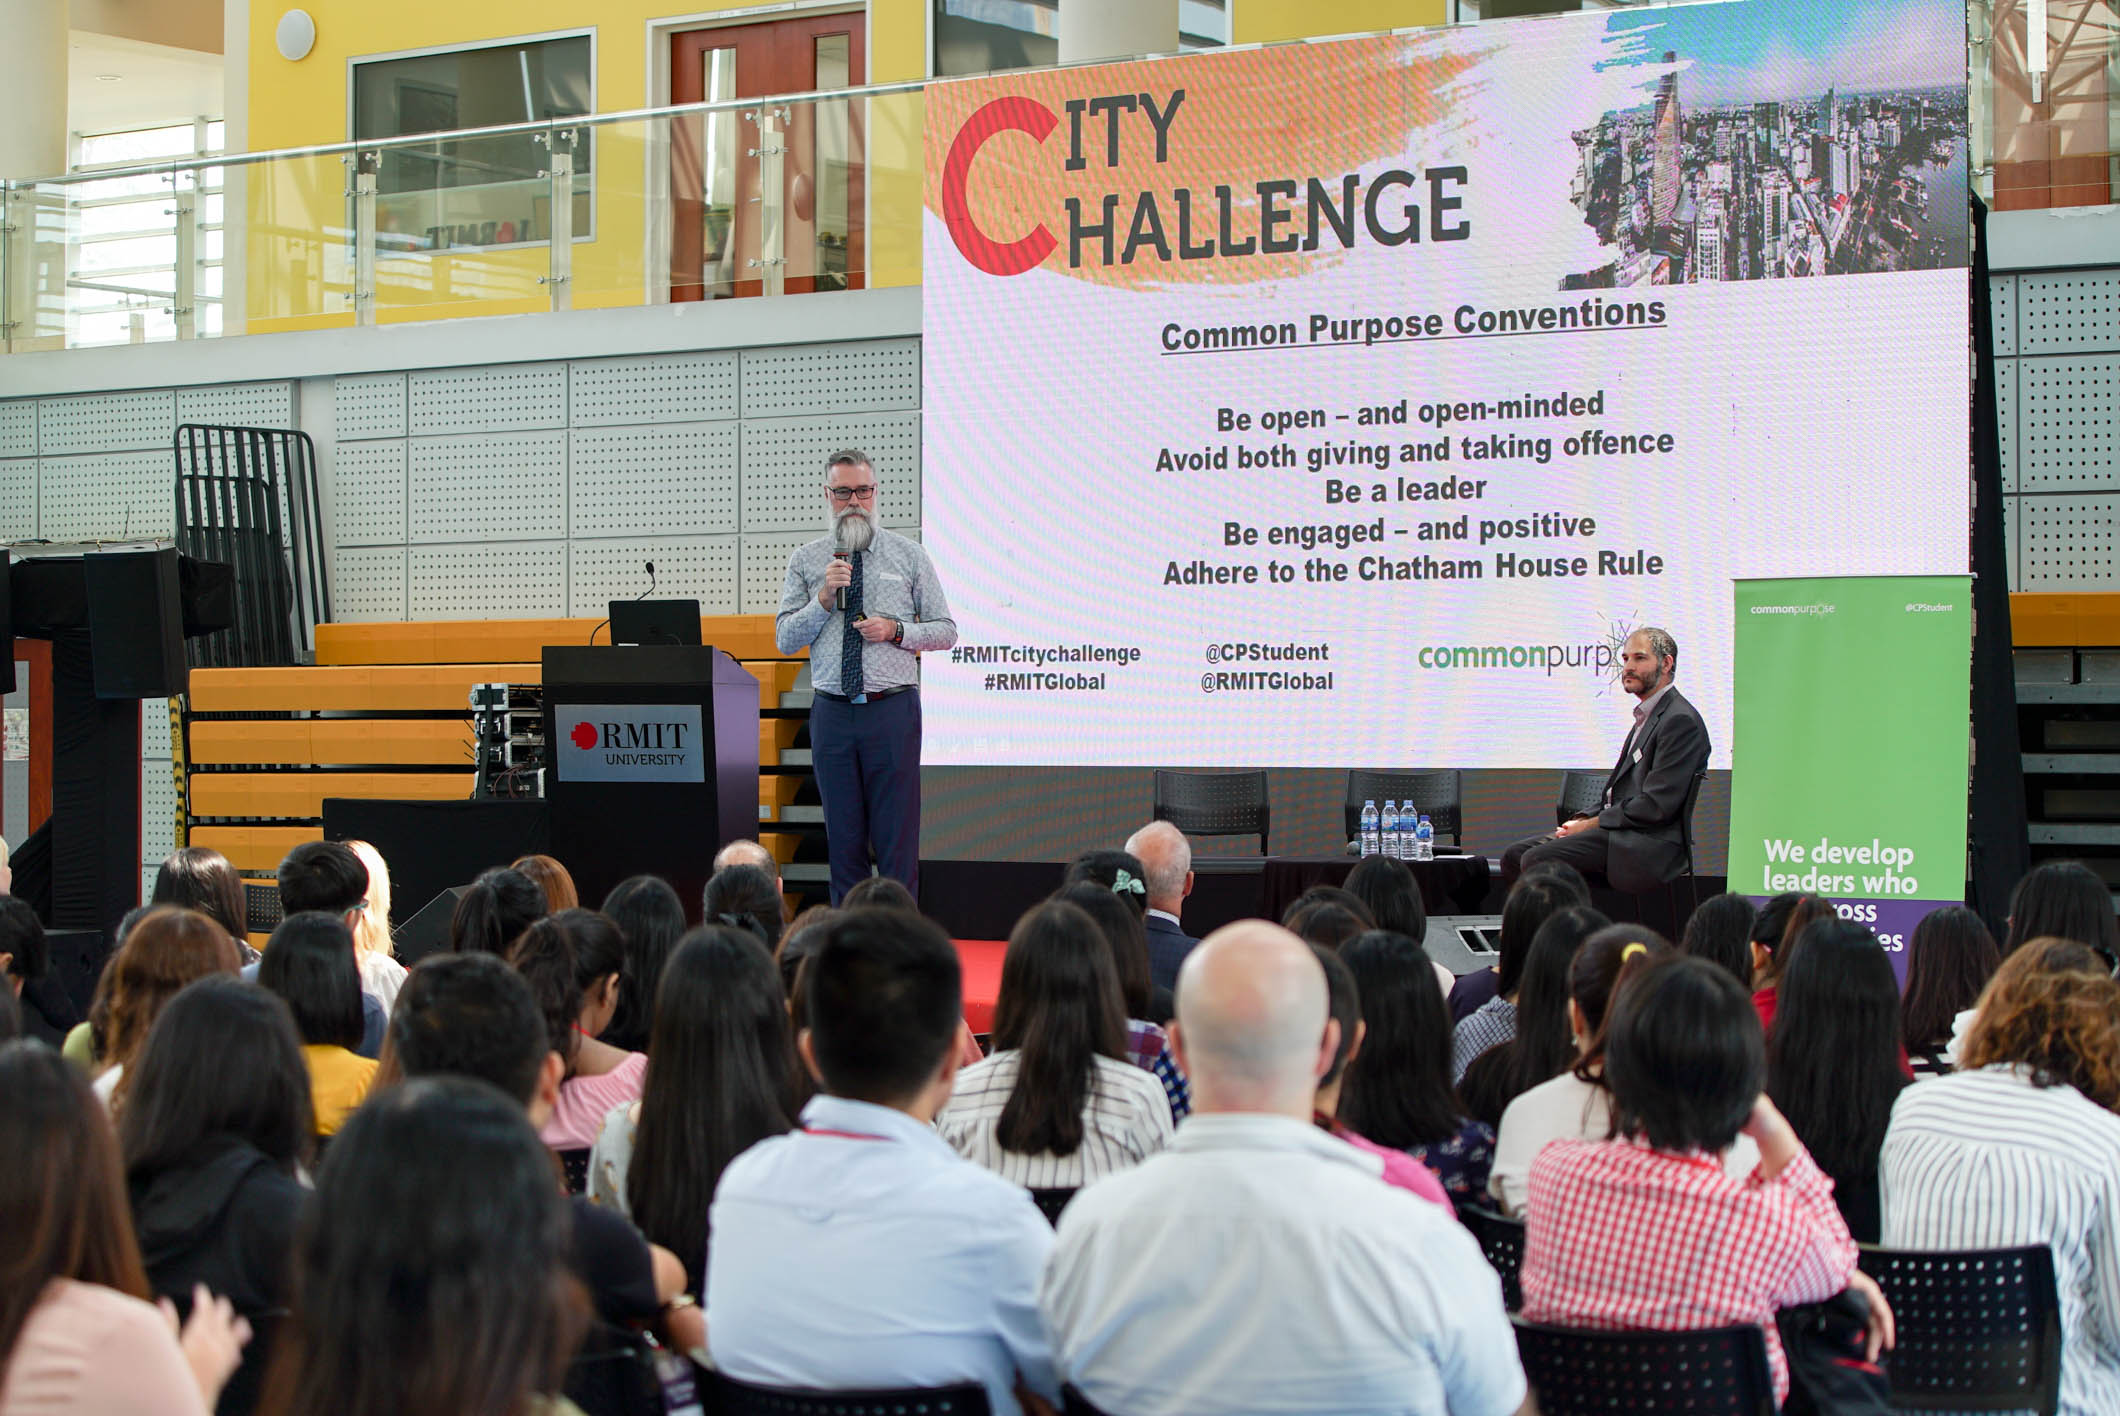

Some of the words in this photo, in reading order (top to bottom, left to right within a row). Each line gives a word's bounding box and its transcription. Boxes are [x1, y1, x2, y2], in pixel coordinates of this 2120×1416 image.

[1162, 323, 1297, 351] Common
[1309, 314, 1443, 346] Purpose
[1454, 298, 1667, 334] Conventions
[1218, 408, 1251, 431] Be
[1261, 410, 1325, 435] open
[1358, 400, 1406, 425] and
[1419, 390, 1603, 428] open-minded
[1156, 446, 1227, 472] Avoid
[1238, 444, 1296, 468] both
[1308, 441, 1389, 472] giving
[1400, 437, 1449, 462] and
[1462, 434, 1551, 463] taking
[1564, 430, 1674, 455] offence
[1327, 480, 1361, 503] Be
[1372, 484, 1386, 502] a
[1398, 475, 1487, 501] leader
[1225, 522, 1258, 545] Be
[1268, 518, 1383, 550] engaged
[1418, 515, 1467, 540] and
[1480, 512, 1595, 545] positive
[1164, 561, 1257, 585] Adhere
[1269, 560, 1294, 583] to
[1305, 558, 1347, 581] the
[1359, 555, 1482, 580] Chatham
[1497, 553, 1587, 577] House
[1599, 550, 1663, 575] Rule
[1905, 603, 1953, 613] @CPStudent
[952, 645, 1140, 666] #RMITcitychallenge
[1207, 643, 1328, 664] @CPStudent
[1418, 644, 1621, 677] commonpurp
[985, 673, 1104, 690] #RMITGlobal
[1202, 672, 1332, 693] @RMITGlobal
[600, 722, 688, 749] RMIT
[606, 754, 686, 766] UNIVERSITY
[1763, 839, 1805, 863] We
[1811, 837, 1914, 872] develop
[1763, 865, 1855, 893] leaders
[1862, 868, 1918, 894] who
